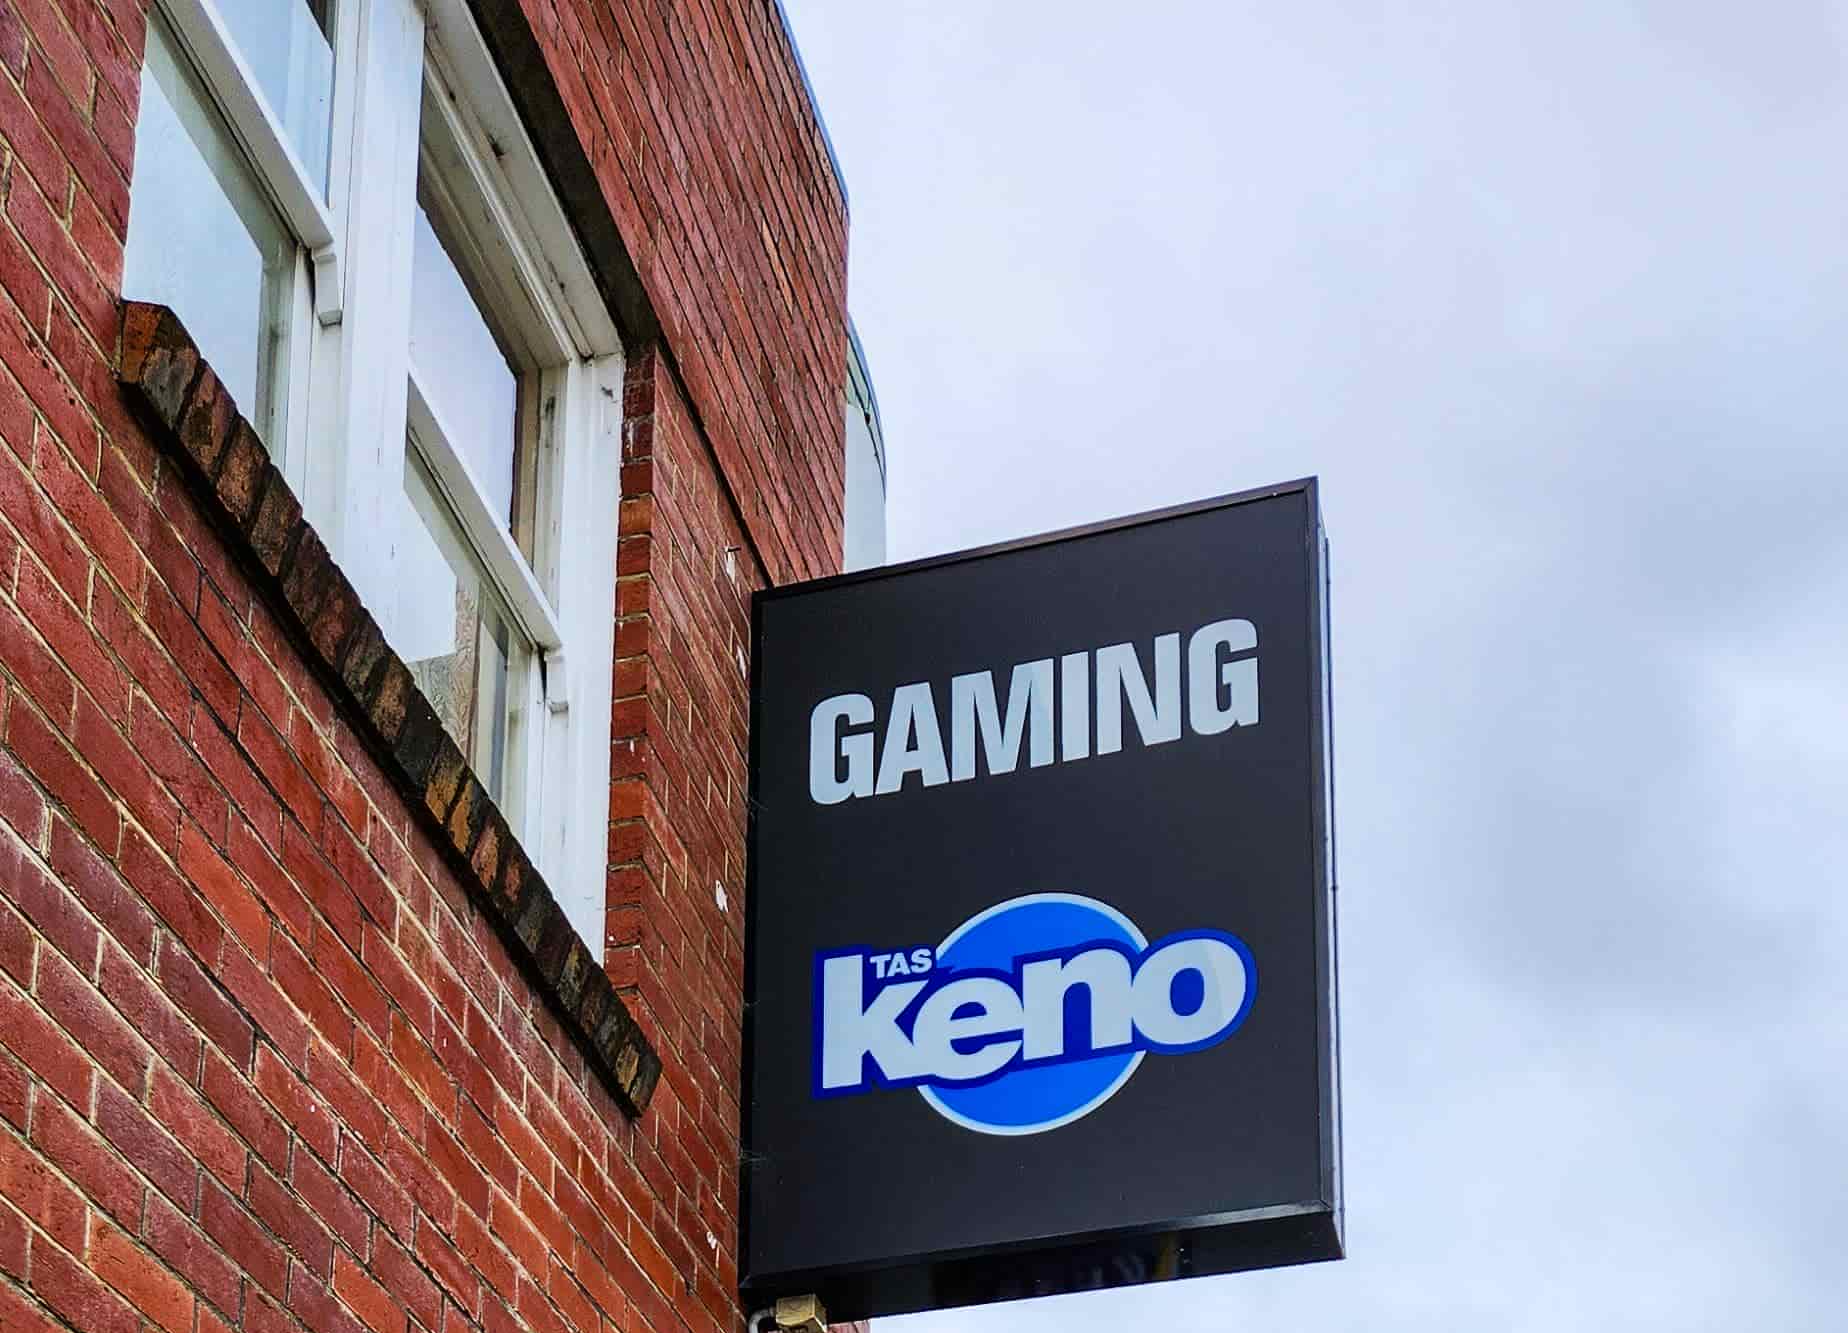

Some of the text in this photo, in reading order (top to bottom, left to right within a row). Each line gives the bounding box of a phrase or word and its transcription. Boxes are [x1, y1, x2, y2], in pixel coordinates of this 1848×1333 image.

[809, 618, 1260, 805] GAMING
[823, 936, 1247, 1088] keno
[870, 948, 932, 980] TAS
